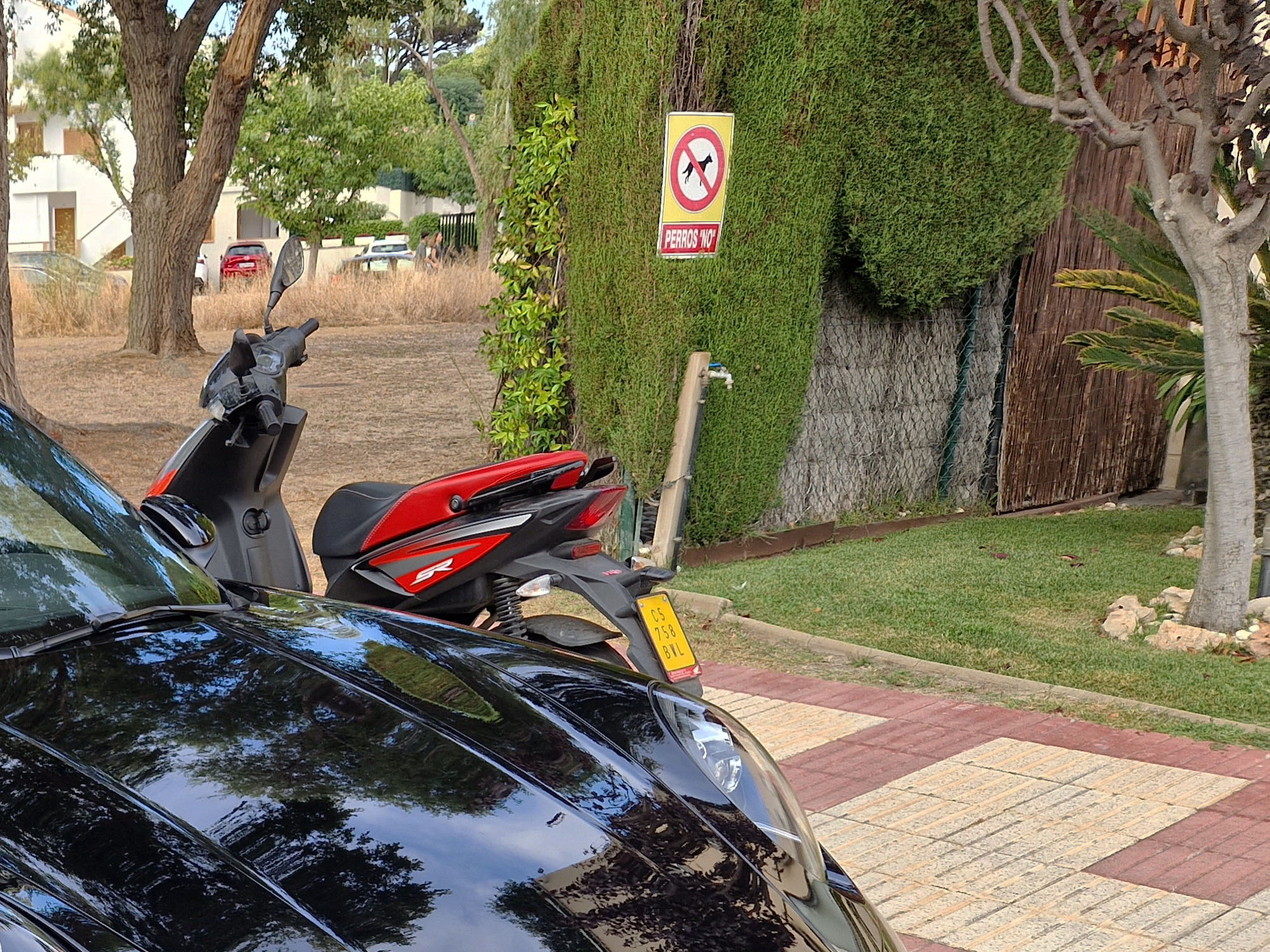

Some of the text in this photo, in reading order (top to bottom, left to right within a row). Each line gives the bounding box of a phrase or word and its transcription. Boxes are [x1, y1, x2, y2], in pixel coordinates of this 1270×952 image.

[665, 228, 699, 249] PERROS
[410, 557, 454, 587] SR
[650, 607, 666, 623] C5
[654, 624, 676, 641] 758
